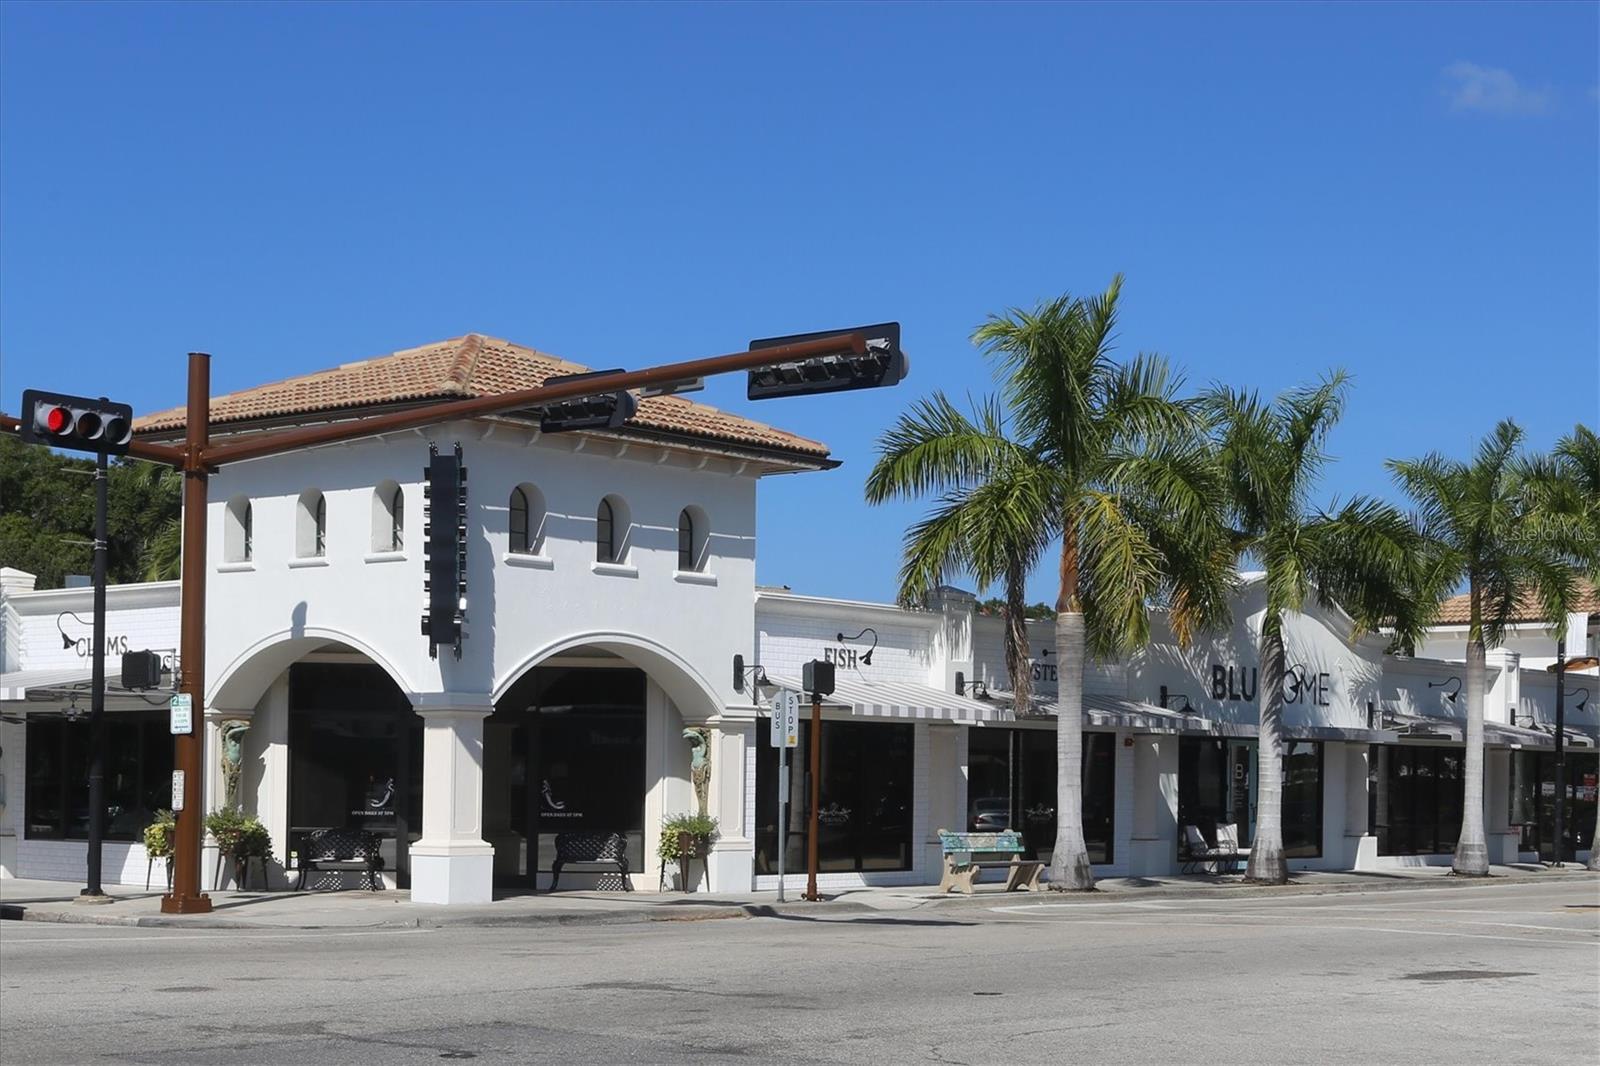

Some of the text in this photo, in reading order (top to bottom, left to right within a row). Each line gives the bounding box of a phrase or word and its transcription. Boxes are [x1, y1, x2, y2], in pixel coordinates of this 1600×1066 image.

[76, 635, 127, 657] CLMS
[824, 648, 857, 669] FISH
[1212, 664, 1330, 706] BLU OME
